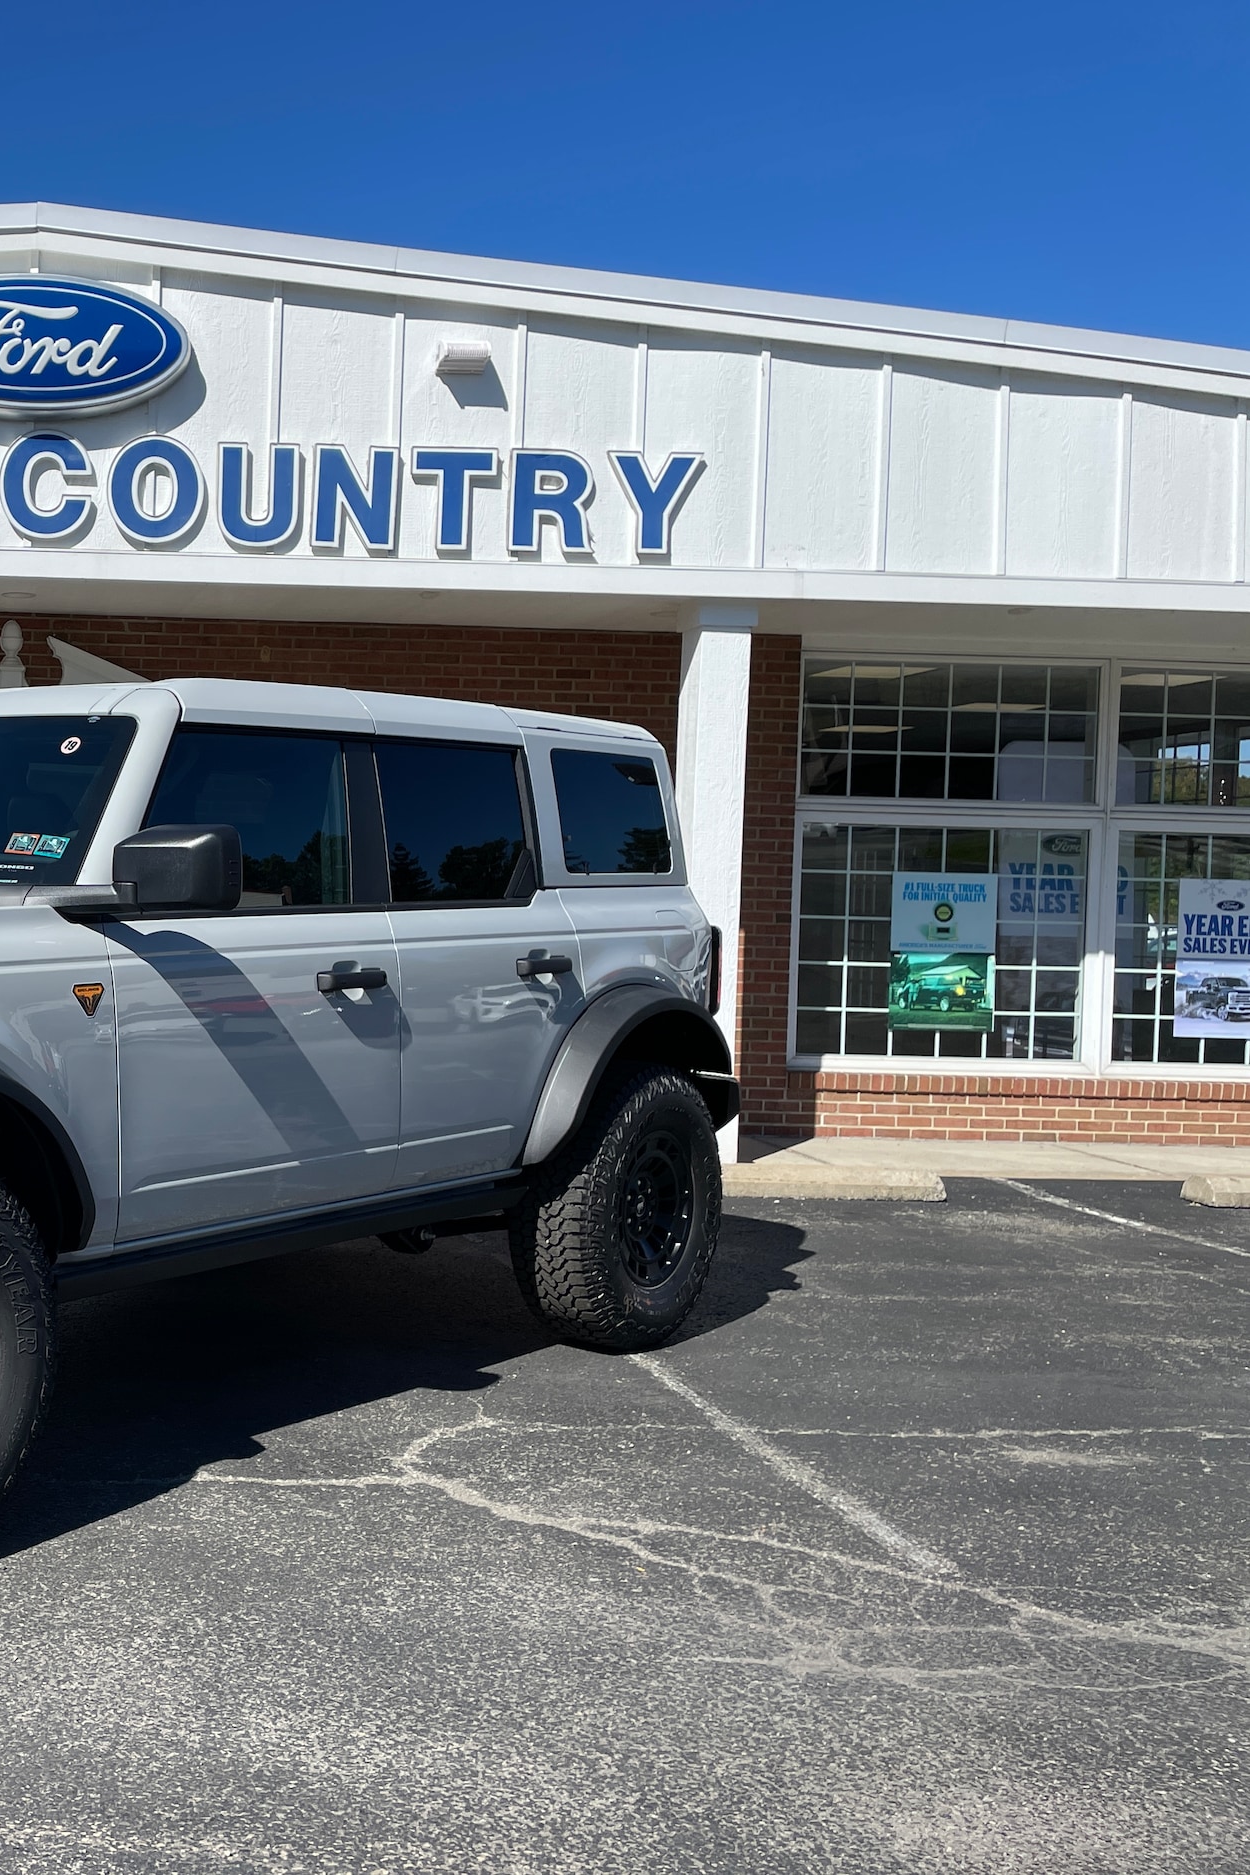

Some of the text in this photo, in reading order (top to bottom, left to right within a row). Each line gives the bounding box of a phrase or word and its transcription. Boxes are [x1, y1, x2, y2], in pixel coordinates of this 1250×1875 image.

[0, 428, 704, 556] COUNTRY
[64, 740, 78, 751] 19
[1008, 862, 1074, 891] YEAR
[904, 882, 986, 893] #1 FULL-SIZE TRUCK
[903, 892, 987, 904] FOR INITIAL QUALITY
[1010, 892, 1066, 914] SALES
[1221, 902, 1239, 911] Ford
[1183, 914, 1234, 936] YEAR
[1183, 936, 1227, 954] SALES
